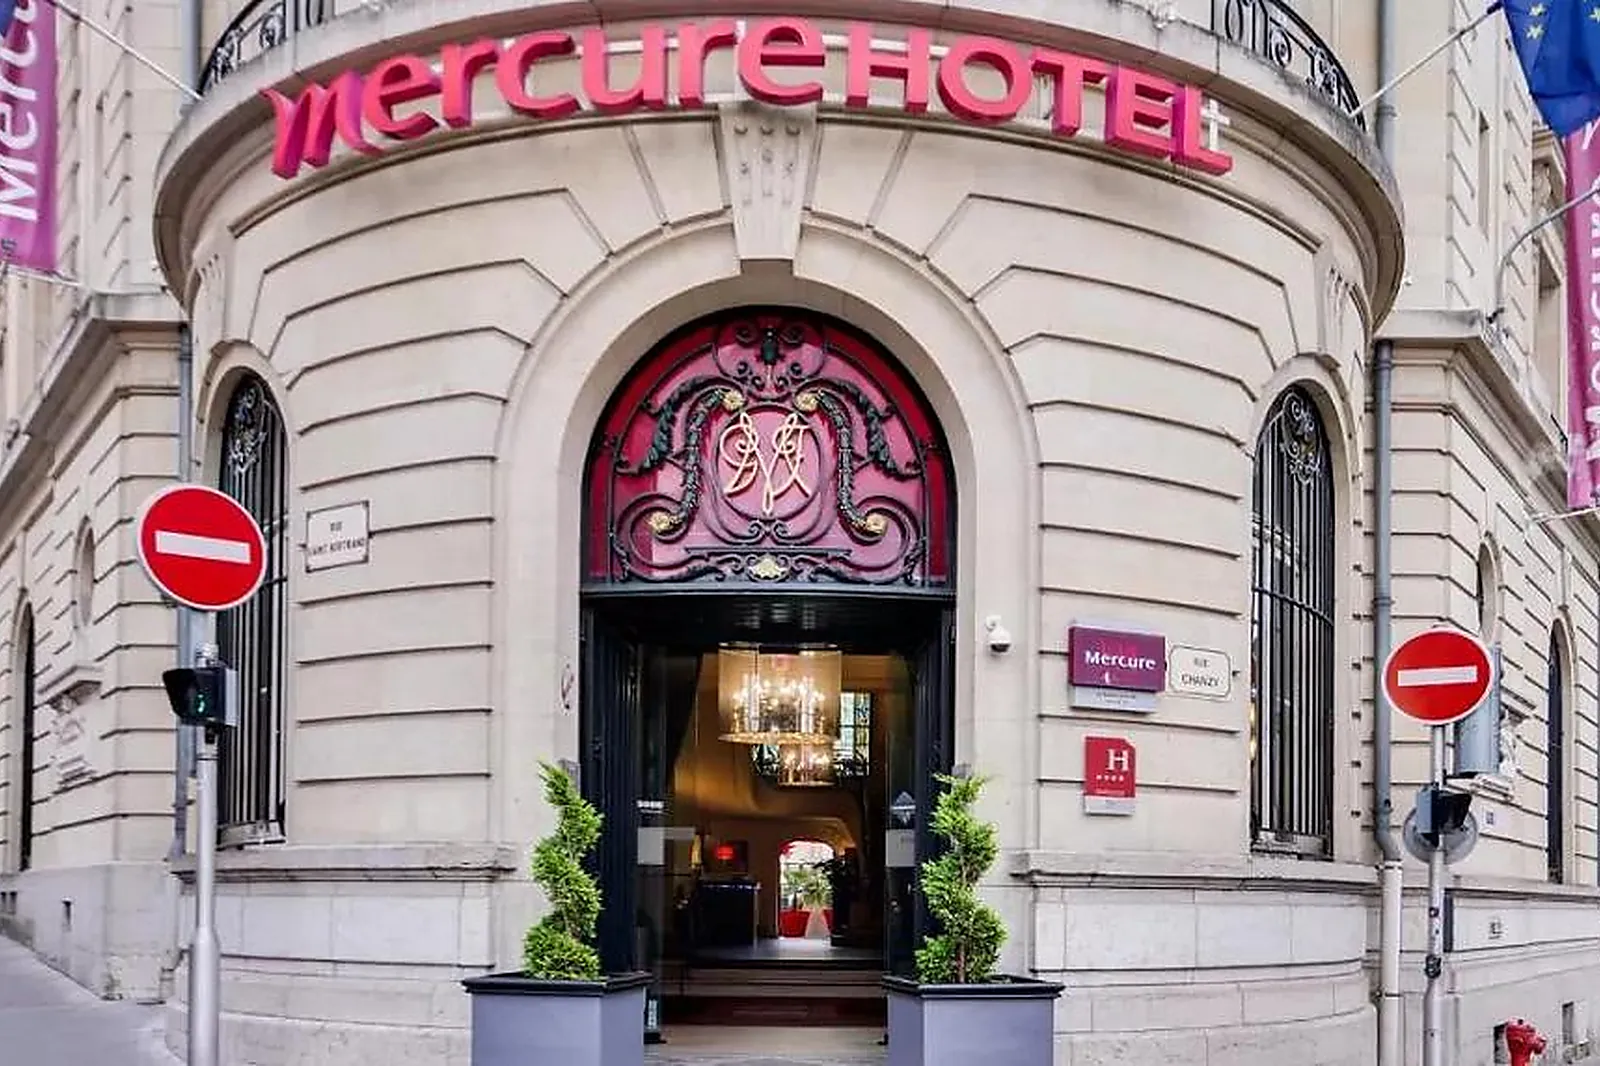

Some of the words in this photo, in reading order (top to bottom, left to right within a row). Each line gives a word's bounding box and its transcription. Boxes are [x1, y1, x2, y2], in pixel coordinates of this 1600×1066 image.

[263, 17, 825, 179] Mercure
[844, 22, 1233, 175] HOTEL
[1085, 650, 1157, 671] Mercure
[1181, 673, 1220, 687] CHANZY
[1106, 748, 1129, 771] H
